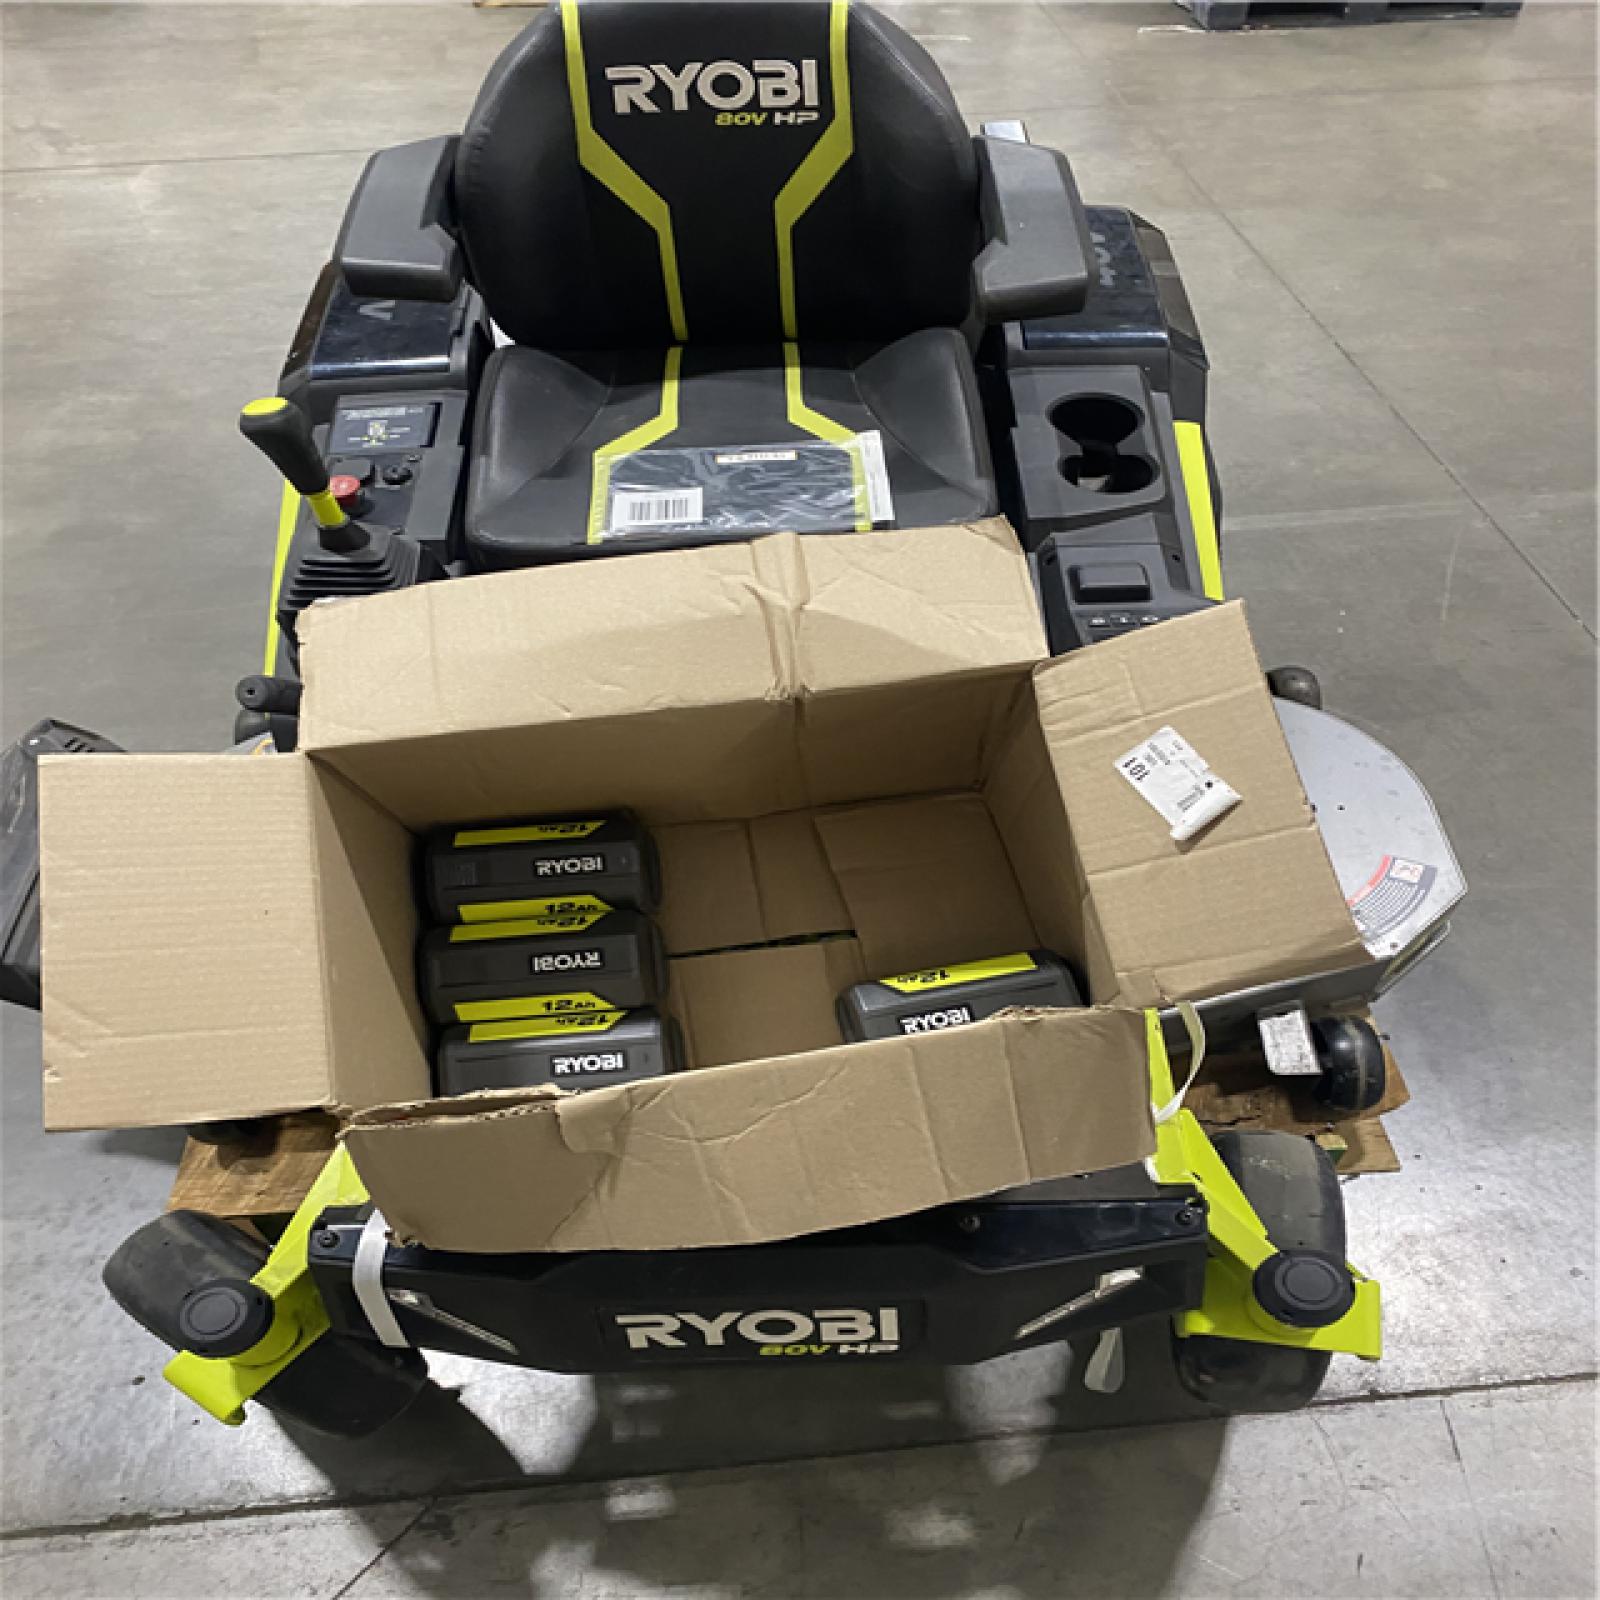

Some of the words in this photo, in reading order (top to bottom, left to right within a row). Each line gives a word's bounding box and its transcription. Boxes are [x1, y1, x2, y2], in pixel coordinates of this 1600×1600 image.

[605, 59, 819, 113] RYOBI
[715, 112, 768, 125] 80V
[774, 112, 819, 125] HP
[534, 856, 603, 876] RYOBI
[544, 901, 599, 914] 12Ah
[533, 951, 602, 973] RYOBI
[542, 999, 597, 1012] 12Ah
[901, 1006, 971, 1035] RYOBI
[552, 1052, 624, 1076] RYOBI
[615, 1306, 899, 1348] RYOBI
[838, 1344, 899, 1355] HP
